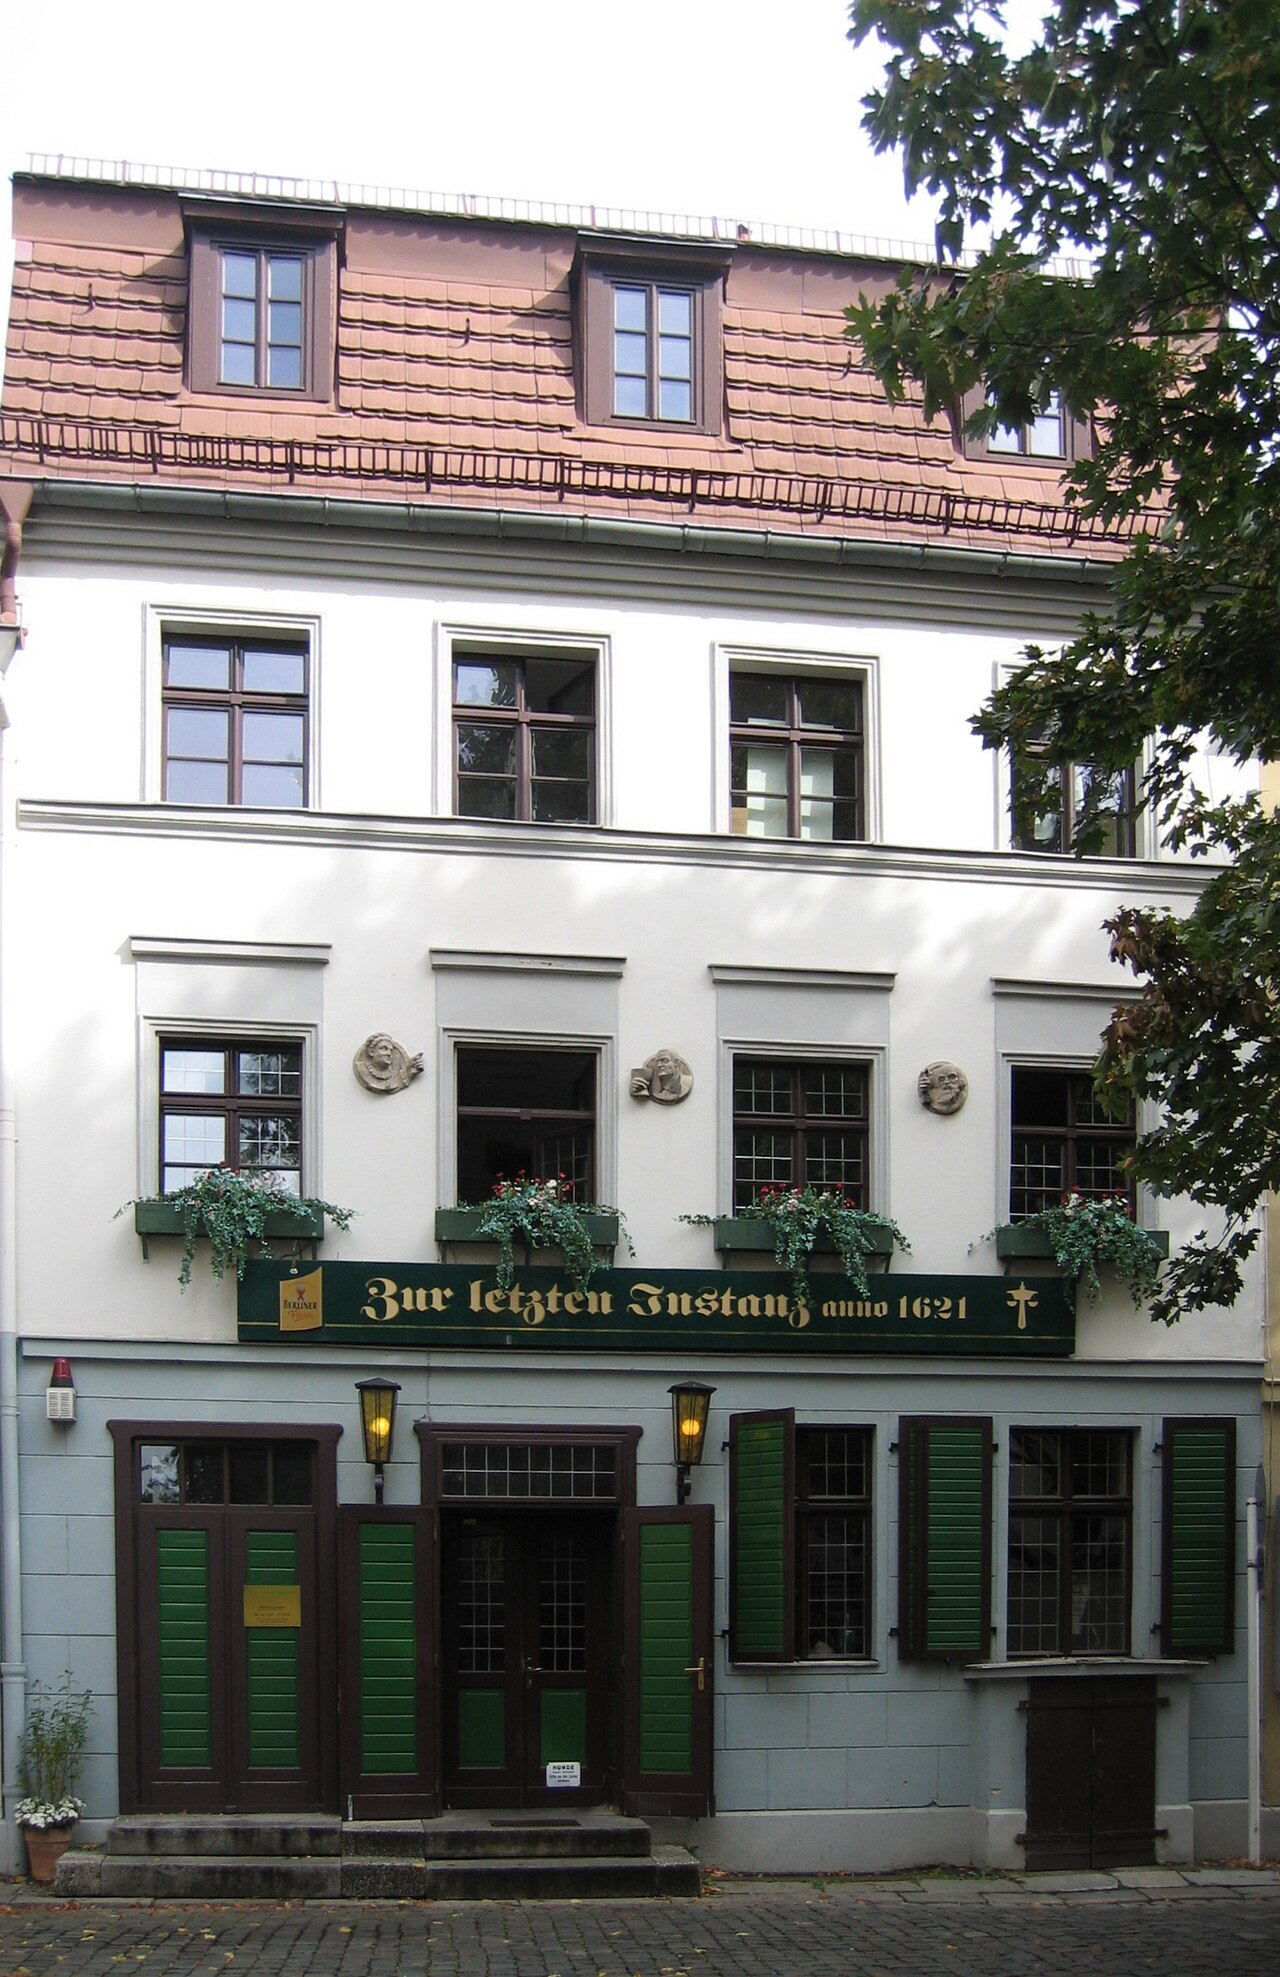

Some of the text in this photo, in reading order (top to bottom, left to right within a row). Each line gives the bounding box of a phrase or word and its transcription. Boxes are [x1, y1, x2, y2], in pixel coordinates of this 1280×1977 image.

[283, 1299, 318, 1310] BERLINER
[360, 1277, 967, 1329] Zur letzten Instanz anno 1621
